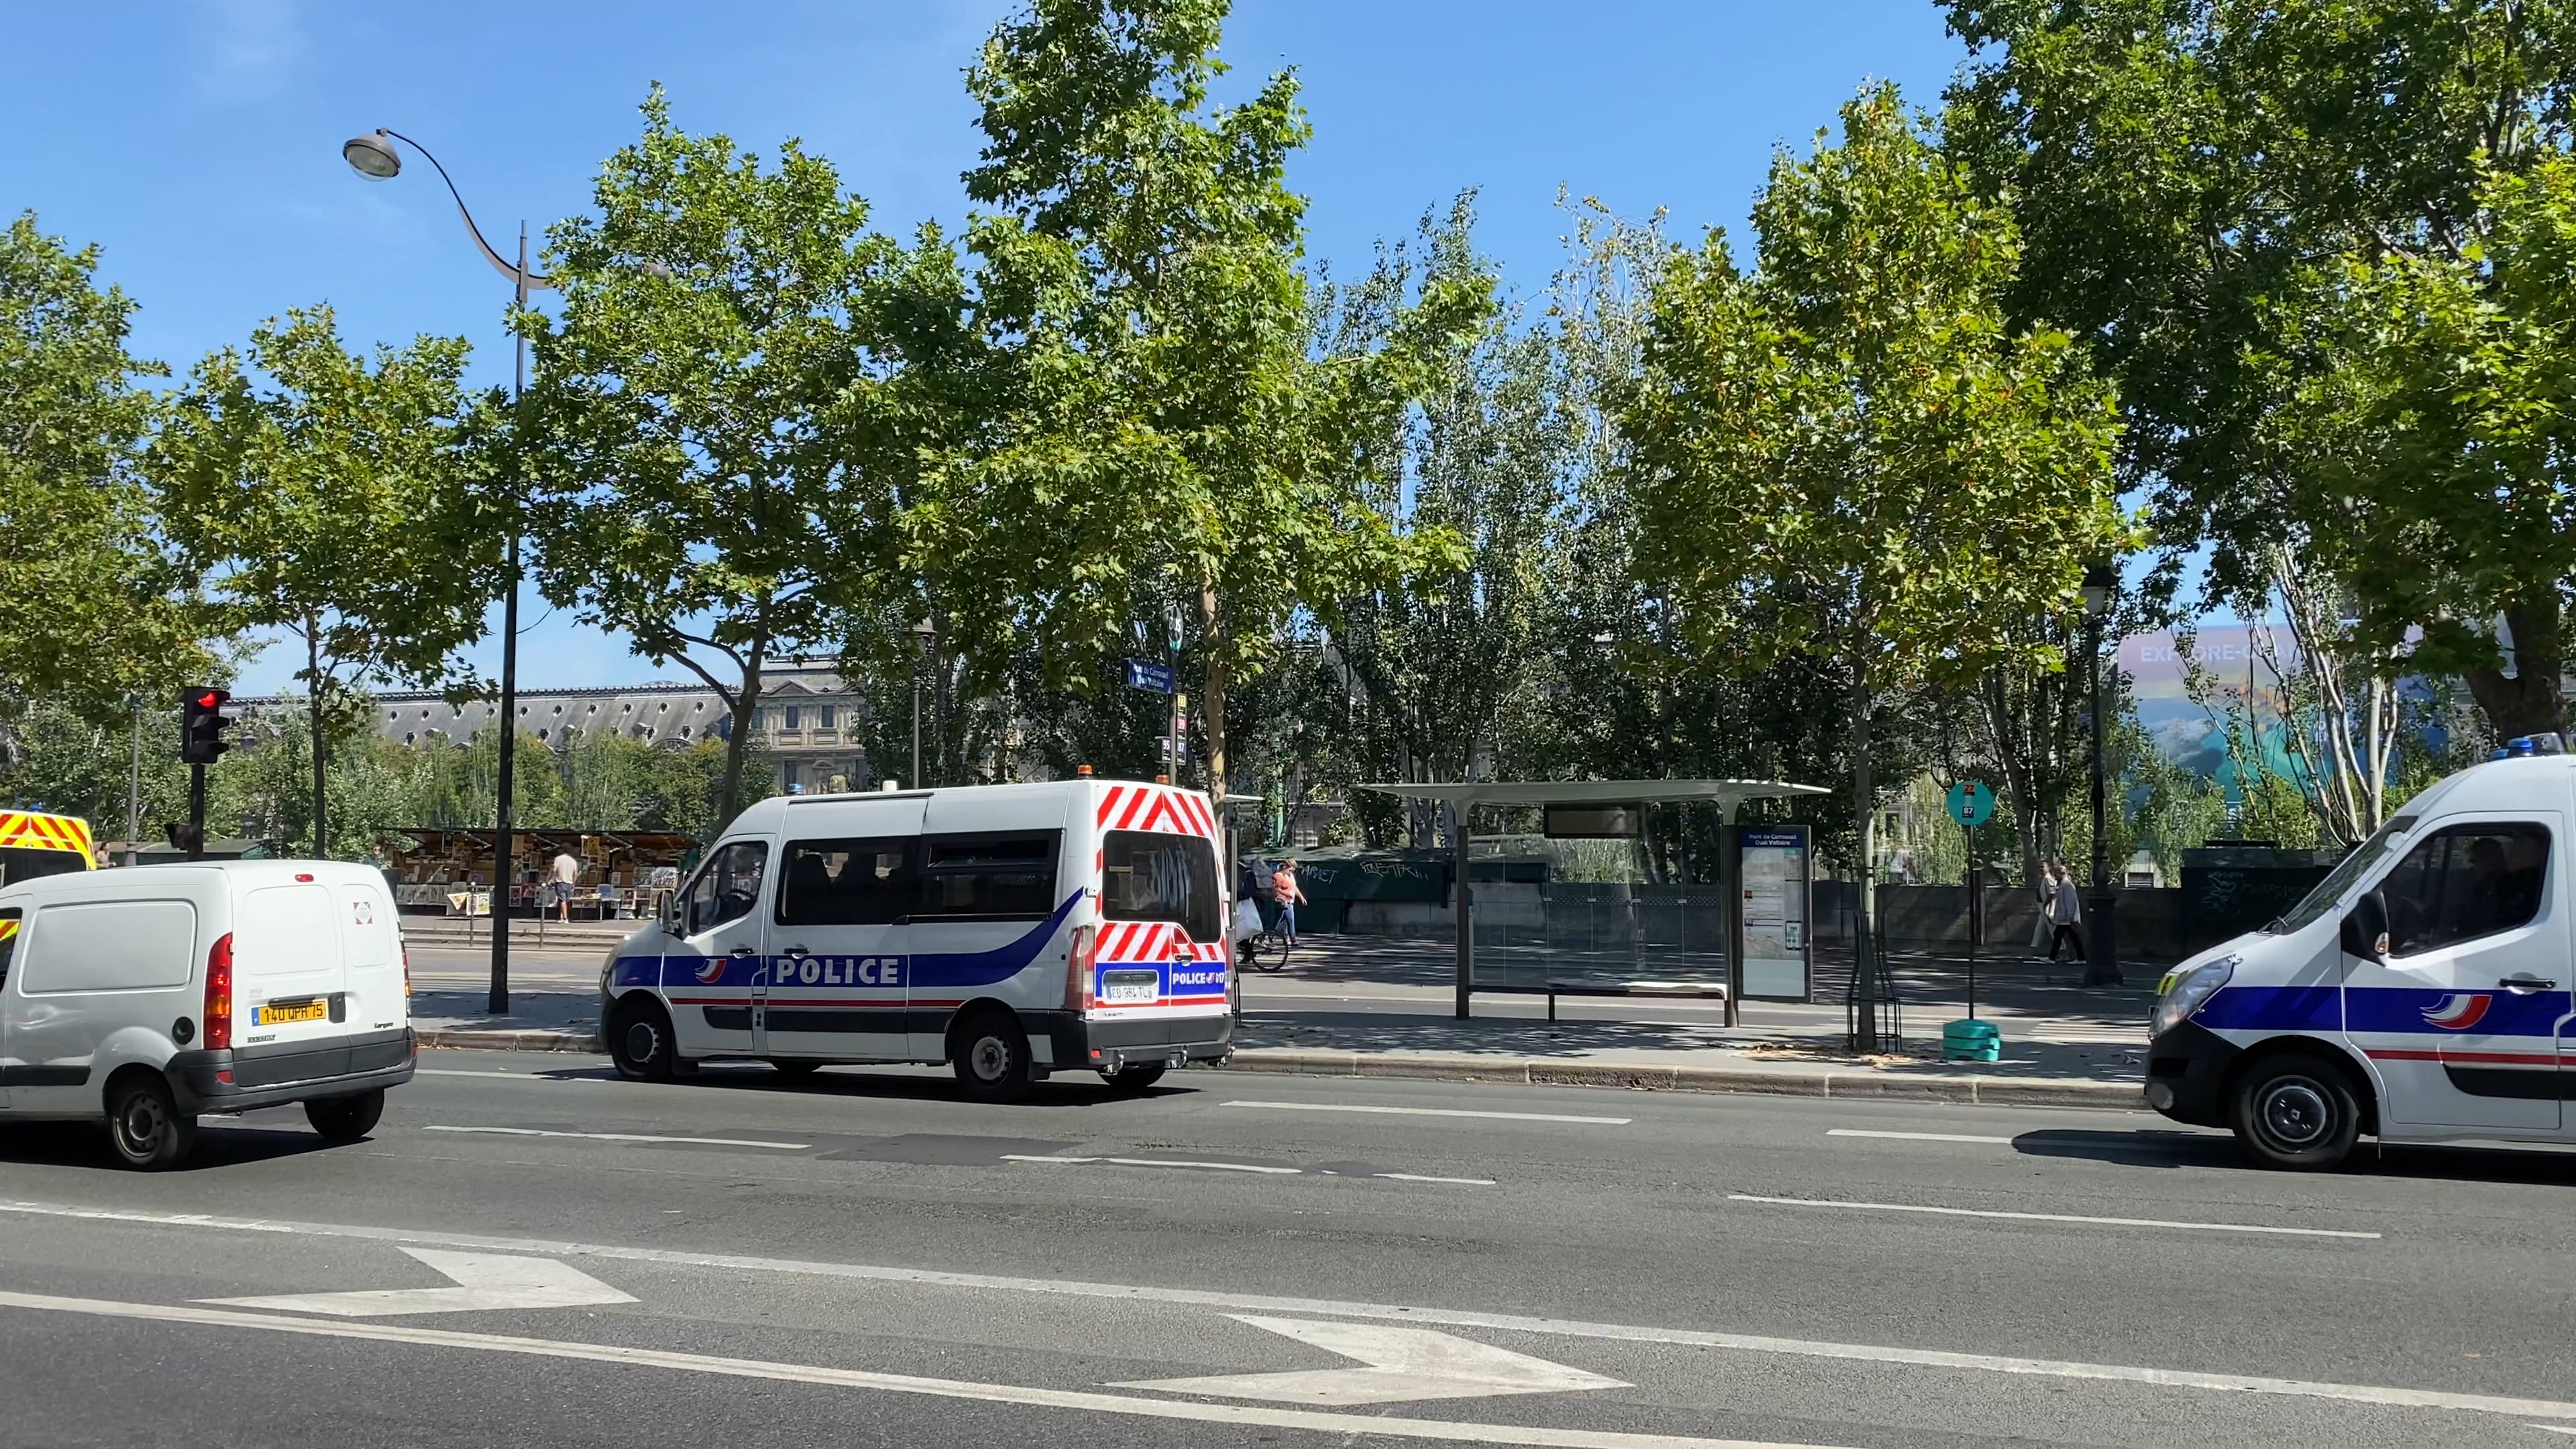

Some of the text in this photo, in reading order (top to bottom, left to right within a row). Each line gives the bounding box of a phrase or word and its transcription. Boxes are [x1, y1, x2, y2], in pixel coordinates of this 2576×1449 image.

[1169, 616, 1181, 632] BUS
[776, 959, 898, 984] POLICE
[1172, 973, 1205, 985] POLICE
[264, 1008, 285, 1022] 140
[311, 1004, 323, 1017] 75
